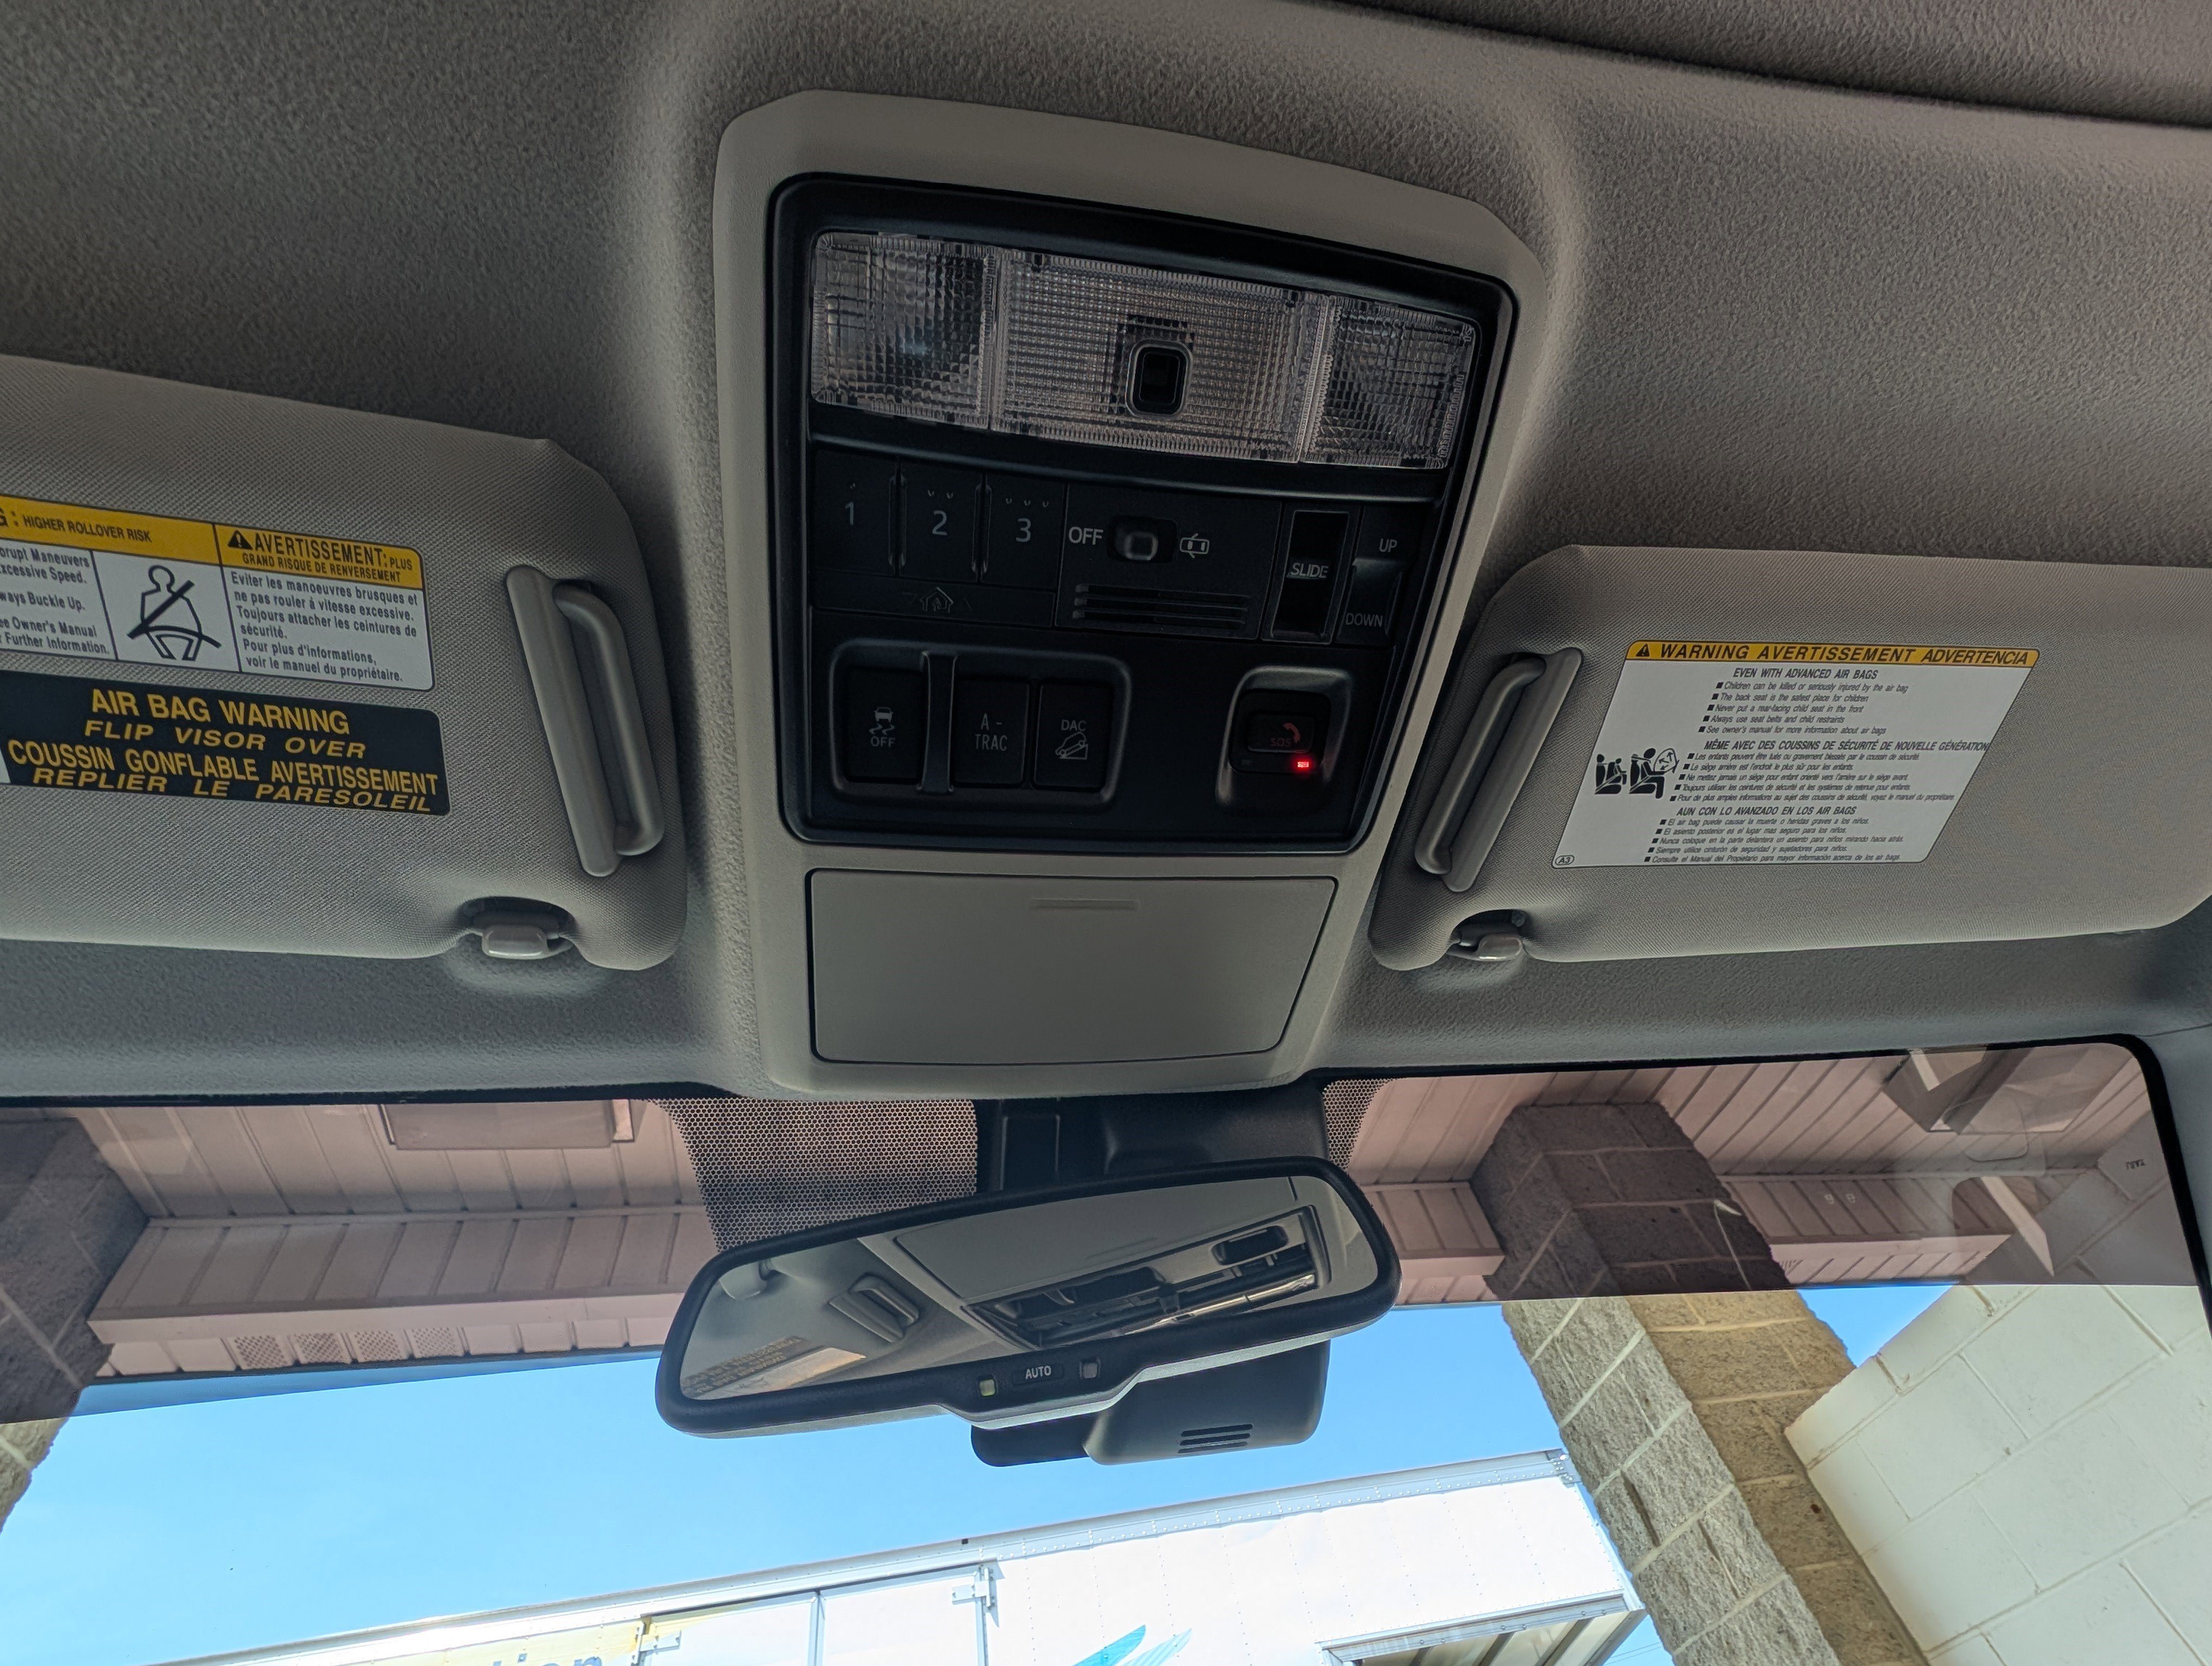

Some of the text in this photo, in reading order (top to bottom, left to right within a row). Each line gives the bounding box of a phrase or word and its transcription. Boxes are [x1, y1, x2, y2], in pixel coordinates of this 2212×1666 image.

[845, 502, 854, 526] 1
[932, 510, 947, 535] 2
[22, 515, 65, 531] HIGHER
[66, 520, 125, 539] ROLLOVER
[126, 528, 152, 542] RISK
[1016, 518, 1031, 542] 3
[1069, 527, 1103, 544] OFF
[255, 533, 412, 569] AVERTISSEMENT: PLUS
[1379, 539, 1397, 552] UP
[30, 549, 89, 568] Maneuvers
[242, 553, 401, 582] GRAND RISQUE DE RENVERSEMENT
[0, 564, 86, 584] xcessive Speed.
[1290, 563, 1328, 578] SLIDE
[266, 575, 282, 589] les
[286, 581, 352, 598] manoeuvres
[355, 586, 404, 604] brusques
[408, 594, 417, 605] et
[27, 592, 65, 608] Buckle
[67, 597, 85, 612] Up.
[234, 591, 247, 601] ne
[250, 593, 270, 606] pas
[273, 595, 305, 608] rouler
[318, 599, 356, 614] vitesse
[359, 606, 414, 621] excessive.
[12, 617, 56, 633] Owner's
[58, 621, 97, 637] Manual
[236, 605, 416, 637] Toujours attacher les ceintures de
[1346, 614, 1382, 627] DOWN
[240, 623, 287, 638] sécurité.
[4, 632, 43, 647] Further
[46, 636, 110, 654] Information.
[243, 638, 376, 665] Pour plus d'informations,
[1661, 644, 2028, 664] WARNING AVERTISSEMENT ADVERTENCIA
[246, 656, 403, 682] voir le manuel du propriétaire.
[1733, 668, 1878, 680] EVEN WITH ADVANCED AIR BAGS
[1725, 681, 1751, 689] Children
[1767, 682, 1777, 690] be
[1779, 682, 1797, 690] killed
[1808, 683, 1836, 692] seriously
[1861, 683, 1871, 693] by
[1896, 684, 1908, 694] bag
[1721, 692, 1733, 701] The
[1791, 693, 1811, 701] safest
[1811, 694, 1830, 703] place
[1832, 694, 1842, 702] for
[93, 689, 350, 734] AIR BAG WARNING
[1735, 704, 1748, 714] put
[1848, 704, 1864, 713] front
[1061, 720, 1086, 732] DAC
[1711, 715, 1733, 723] Always
[85, 720, 365, 758] FLIP VISOR OVER
[1774, 725, 1784, 733] for
[1871, 727, 1886, 736] bags
[871, 736, 895, 747] OFF
[976, 734, 1007, 751] TRAC
[1270, 738, 1292, 747] SOS
[1703, 739, 1989, 751] MÊME AVEC DES COUSSINS DE SÉCURITÉ DE NOUVELLE GÉNÉRATION
[8, 740, 438, 795] COUSSIN GONFLABLE AVERTISSEMENT
[34, 768, 429, 811] REPLIER LE PARESOLEIL
[1699, 807, 1718, 816] CON
[1719, 806, 1732, 815] LO
[1734, 806, 1778, 815] AVANZADO
[1781, 806, 1795, 815] EN
[1796, 806, 1814, 815] LOS
[1816, 806, 1831, 815] AIR
[1833, 806, 1857, 815] BAGS
[1697, 827, 1725, 835] posterior
[1746, 828, 1761, 836] lugar
[1801, 828, 1816, 836] para
[1025, 1366, 1051, 1380] AUTO
